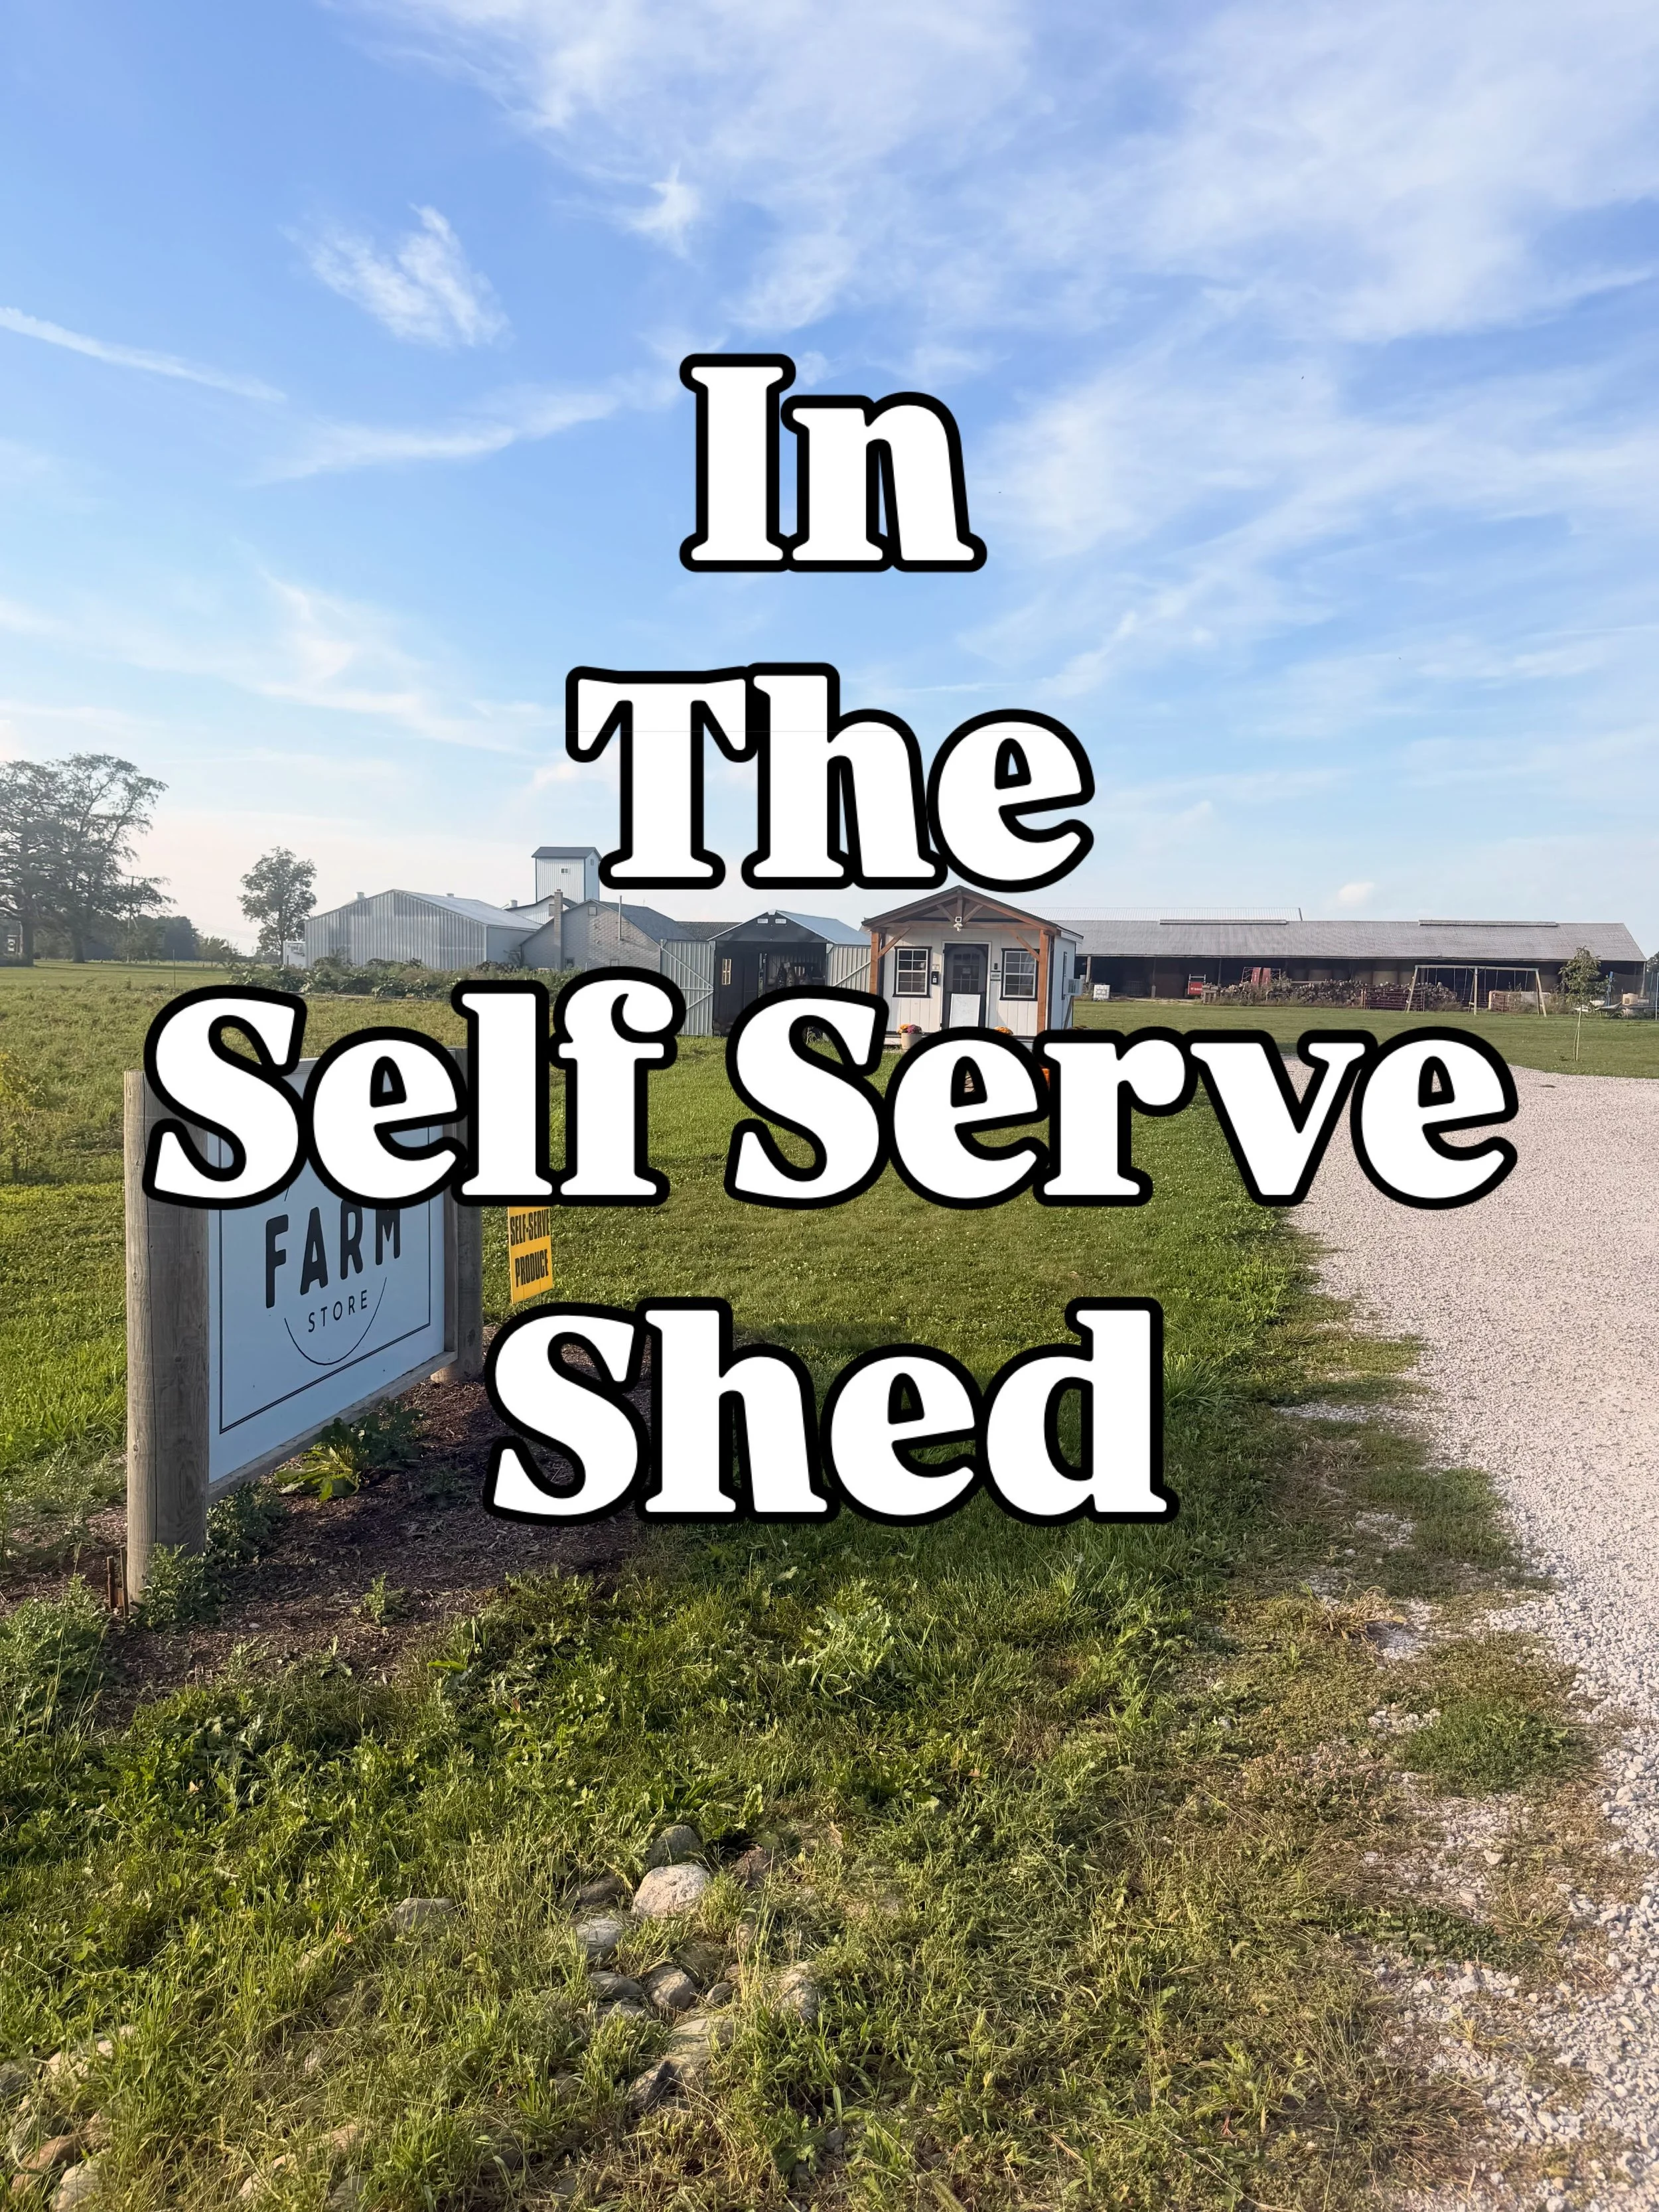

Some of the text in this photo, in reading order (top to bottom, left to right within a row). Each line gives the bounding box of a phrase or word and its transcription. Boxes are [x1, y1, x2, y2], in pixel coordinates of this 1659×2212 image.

[510, 1208, 551, 1246] SELF-SERVE
[265, 1199, 401, 1309] FARM
[514, 1249, 549, 1288] PRODUCE
[308, 1290, 368, 1333] STORE
